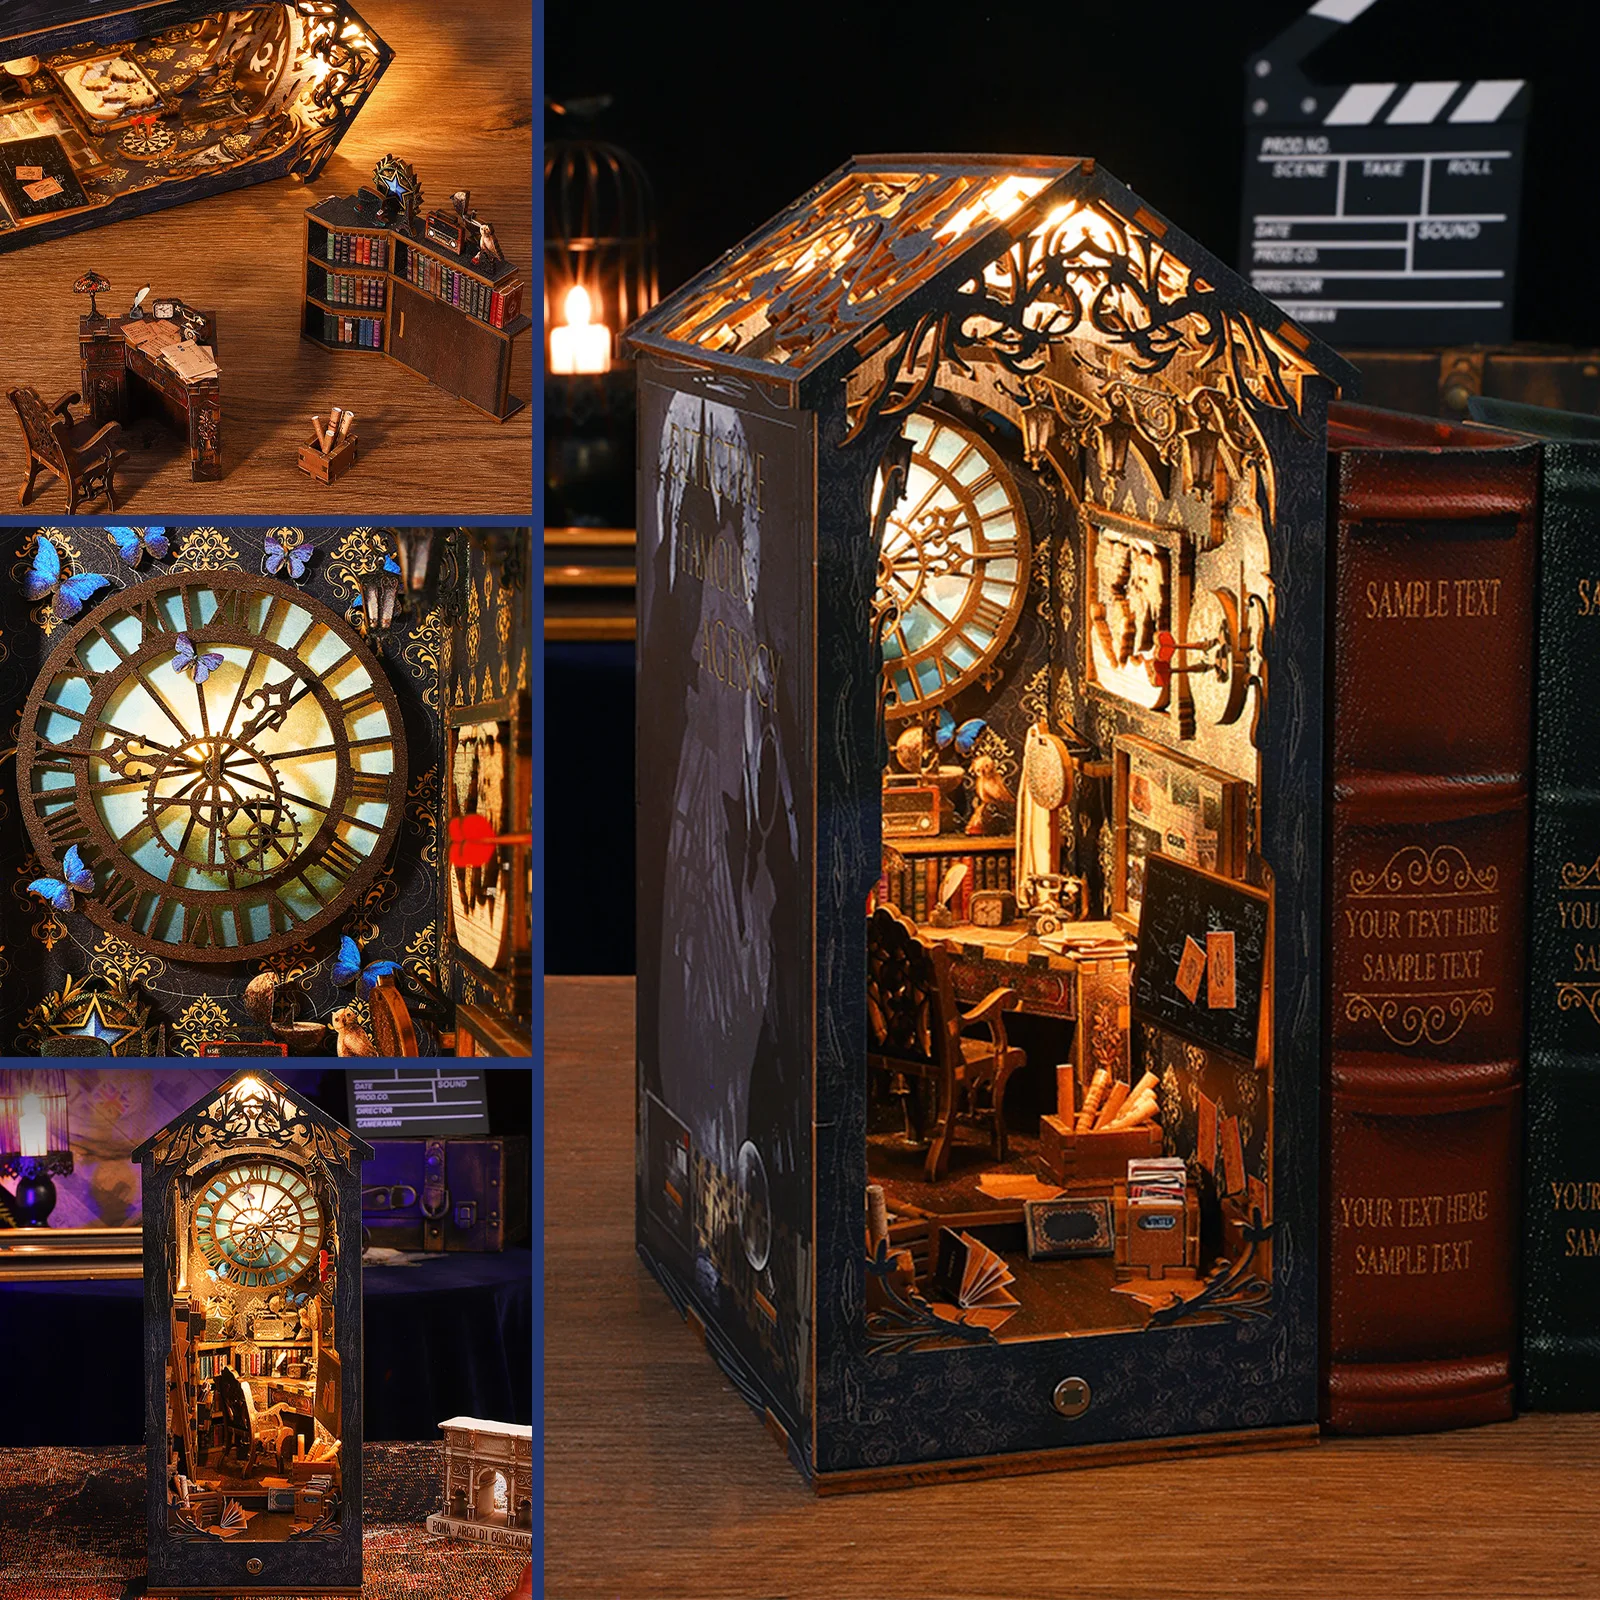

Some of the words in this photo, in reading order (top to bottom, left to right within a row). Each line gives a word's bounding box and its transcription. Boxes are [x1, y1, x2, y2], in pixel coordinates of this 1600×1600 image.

[1272, 162, 1328, 177] SCENE
[1362, 161, 1404, 177] TAKE
[1447, 159, 1492, 175] ROLL
[1254, 223, 1292, 238] DATE
[1418, 222, 1480, 240] SOUND
[1252, 277, 1323, 293] DIRECTOR
[1366, 581, 1449, 618] SAMPLE
[1454, 579, 1501, 616] TEXT
[700, 616, 782, 713] AGENCY
[1345, 910, 1400, 938] YOUR
[1406, 909, 1453, 938] TEXT
[1456, 905, 1499, 936] HERE
[1558, 901, 1600, 929] YOU
[1362, 953, 1436, 981] SAMPLE
[1440, 949, 1483, 979] TEXT
[1574, 943, 1600, 972] SA
[437, 1080, 467, 1088] SOUND
[356, 1107, 393, 1115] DIRECTOR
[357, 1120, 402, 1128] CAMERAMAN
[1551, 1182, 1600, 1211] YOUR
[1341, 1197, 1393, 1228] YOUR
[1398, 1196, 1444, 1228] TEXT
[1447, 1190, 1488, 1223] HERE
[1355, 1244, 1427, 1275] SAMPLE
[1431, 1240, 1472, 1273] TEXT
[432, 1521, 451, 1535] ROMA
[457, 1525, 476, 1538] ARCO
[479, 1529, 488, 1541] DI
